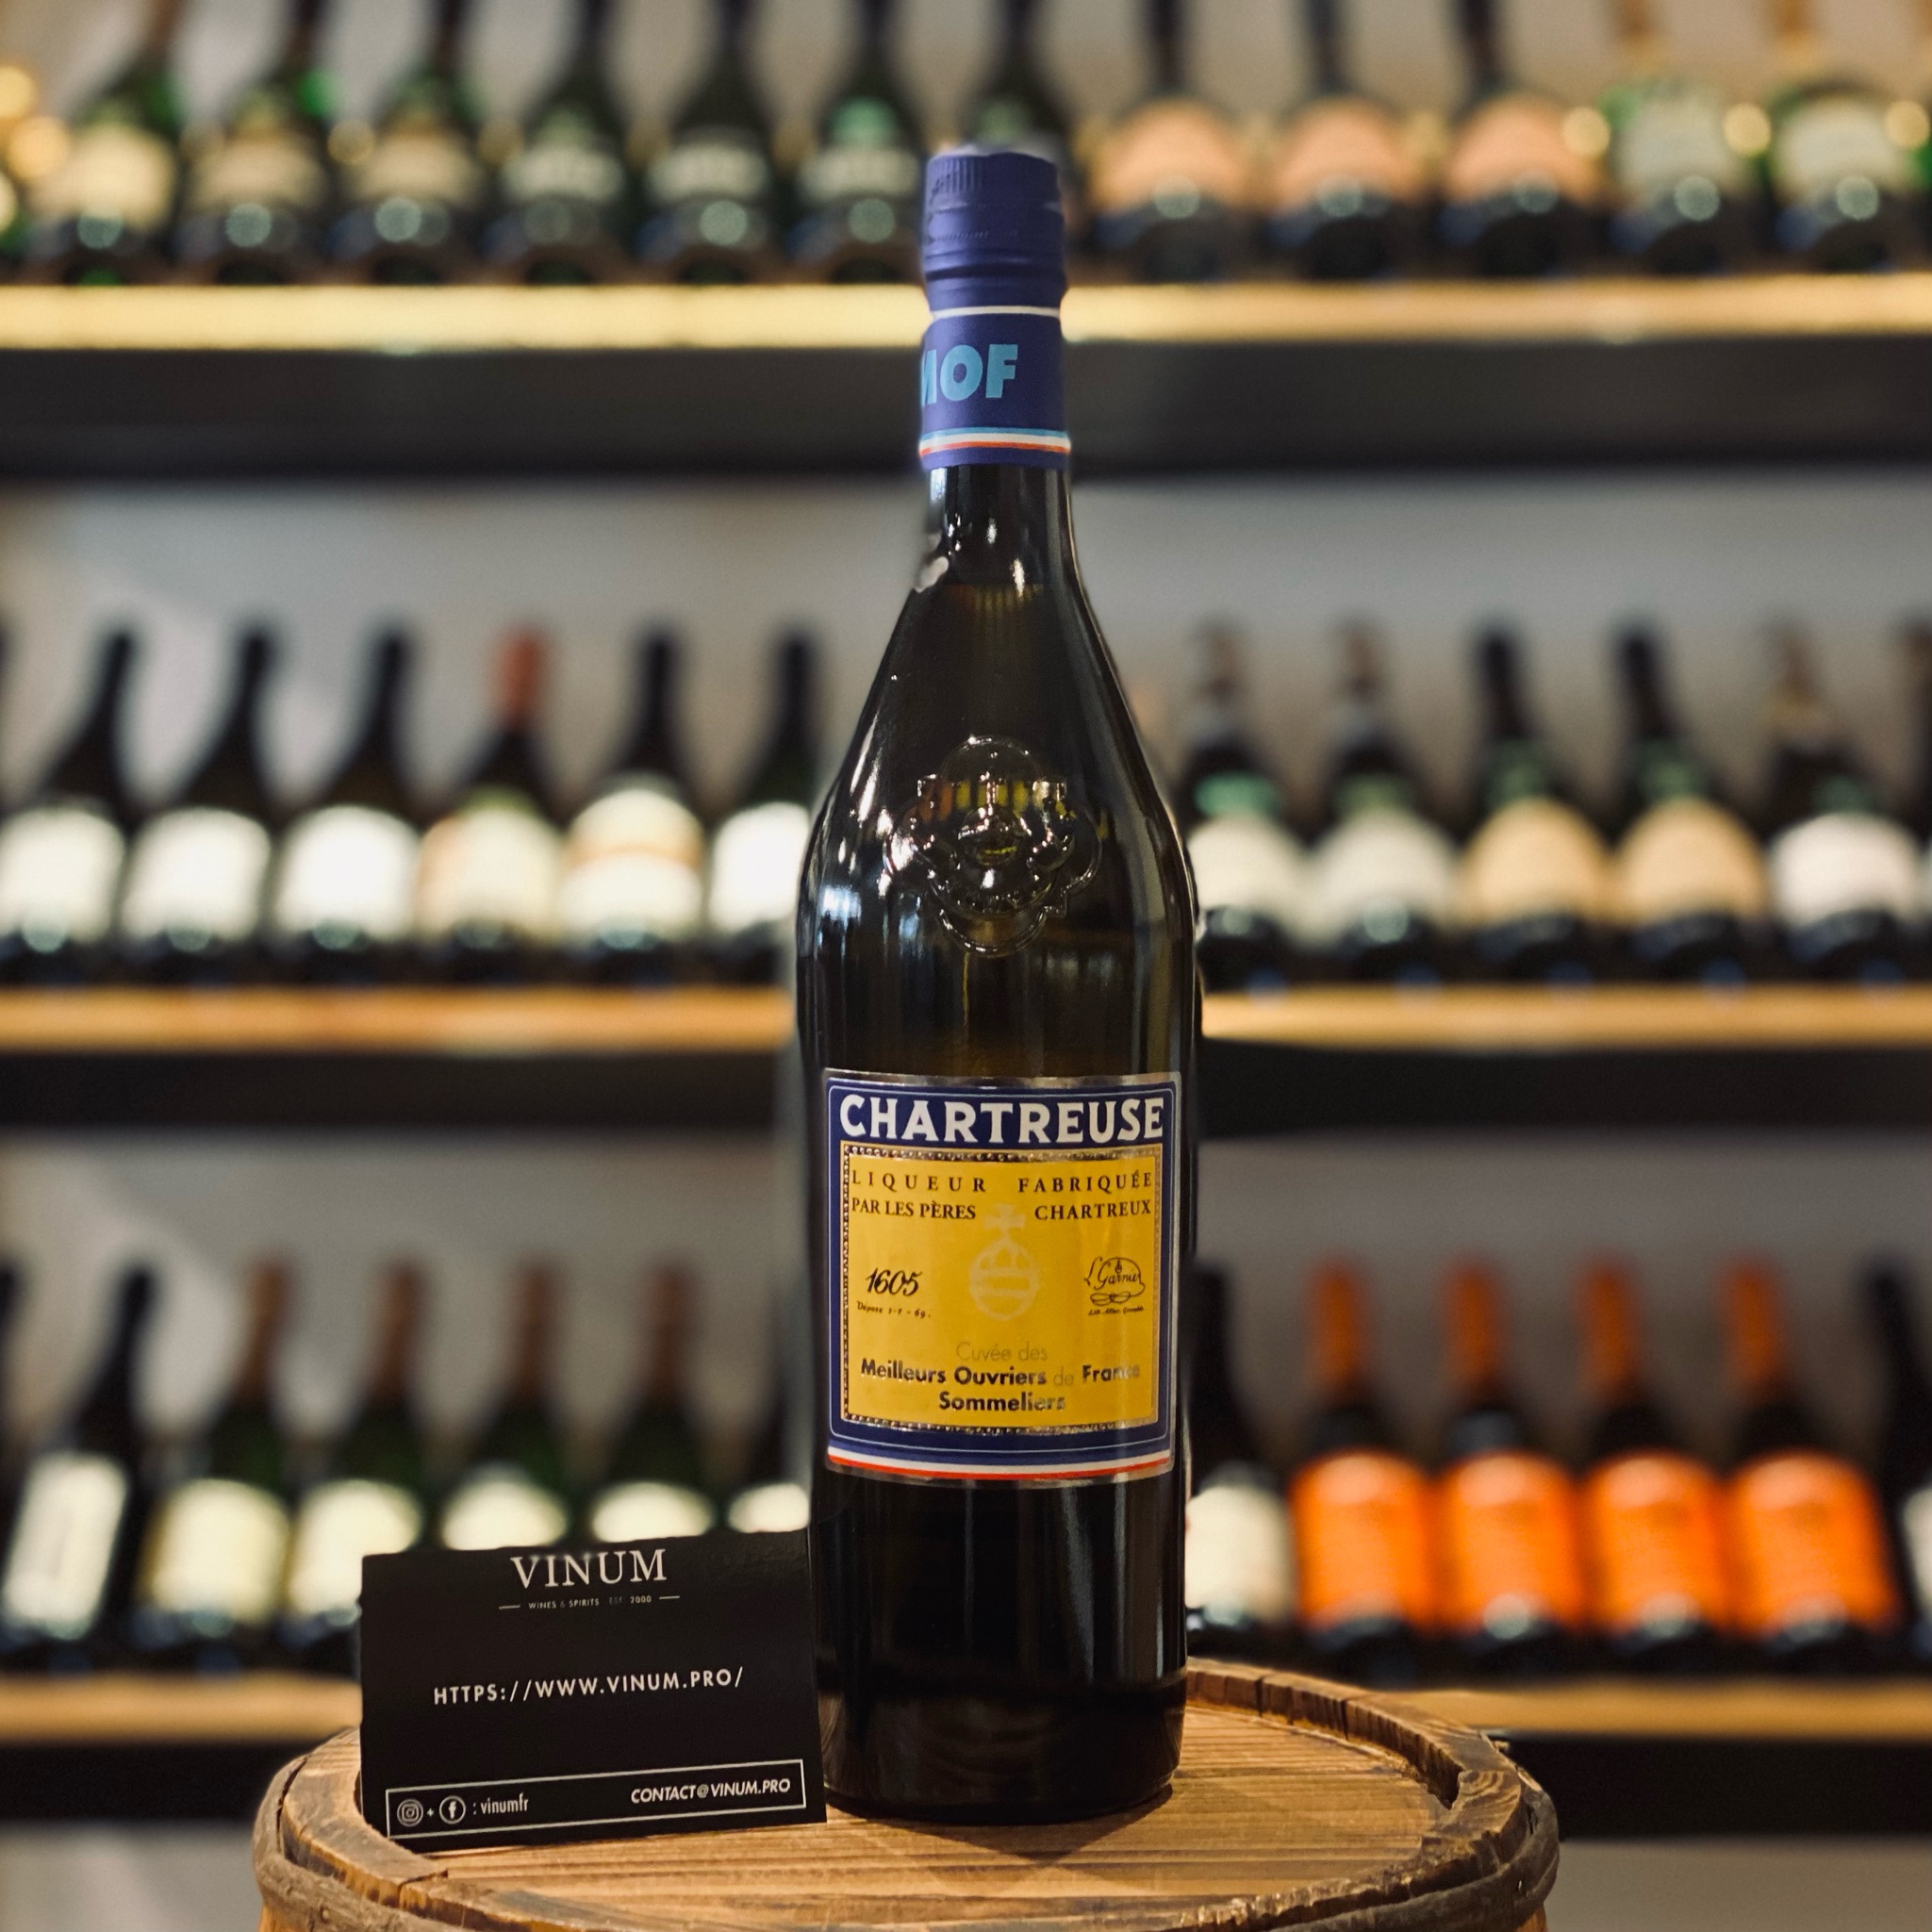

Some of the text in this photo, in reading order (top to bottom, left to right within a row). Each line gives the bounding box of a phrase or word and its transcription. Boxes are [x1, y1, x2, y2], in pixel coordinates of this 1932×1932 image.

[840, 1094, 1164, 1144] CHARTREUSE
[851, 1169, 1153, 1194] LIQUEUR FABRIQUÉE
[851, 1197, 1152, 1222] PAR LES PÈRES CHARTREUX
[865, 1266, 923, 1297] 1605
[955, 1341, 1048, 1362] Cuvée des
[859, 1357, 1141, 1387] Meilleurs Ouvriers de France
[938, 1391, 1066, 1412] Sommeliers
[509, 1548, 668, 1590] VINUM
[528, 1600, 557, 1610] WINES
[569, 1597, 600, 1608] SPIRITS
[629, 1594, 652, 1604] 2000
[433, 1666, 743, 1705] HTTPS://WWW.VINUM.PRO/
[480, 1792, 529, 1815] vinumfr
[630, 1777, 791, 1804] CONTACT@VINUM.PRO
